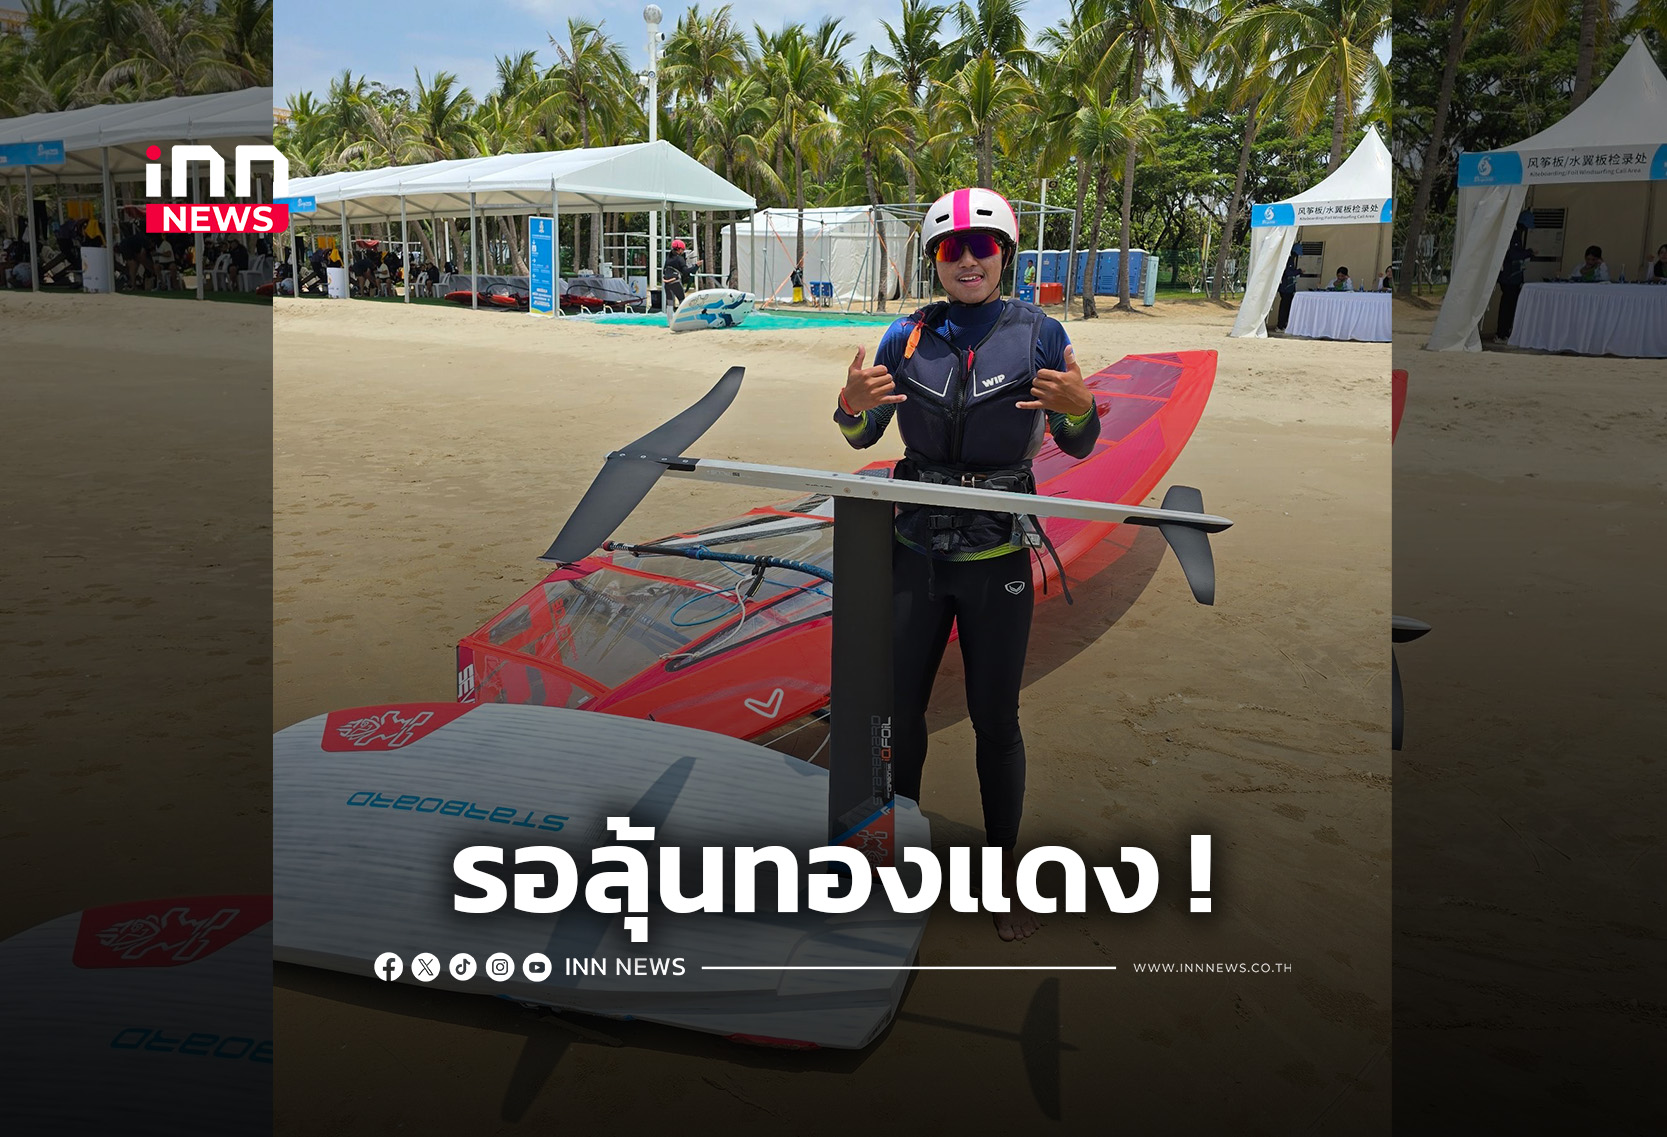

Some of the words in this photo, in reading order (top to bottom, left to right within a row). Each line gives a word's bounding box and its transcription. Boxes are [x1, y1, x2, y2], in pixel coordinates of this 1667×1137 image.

[1527, 152, 1647, 169] 风筝板/水翼板检录处
[1298, 204, 1378, 215] 风筝板/水翼板检录处
[982, 374, 1006, 388] WIP
